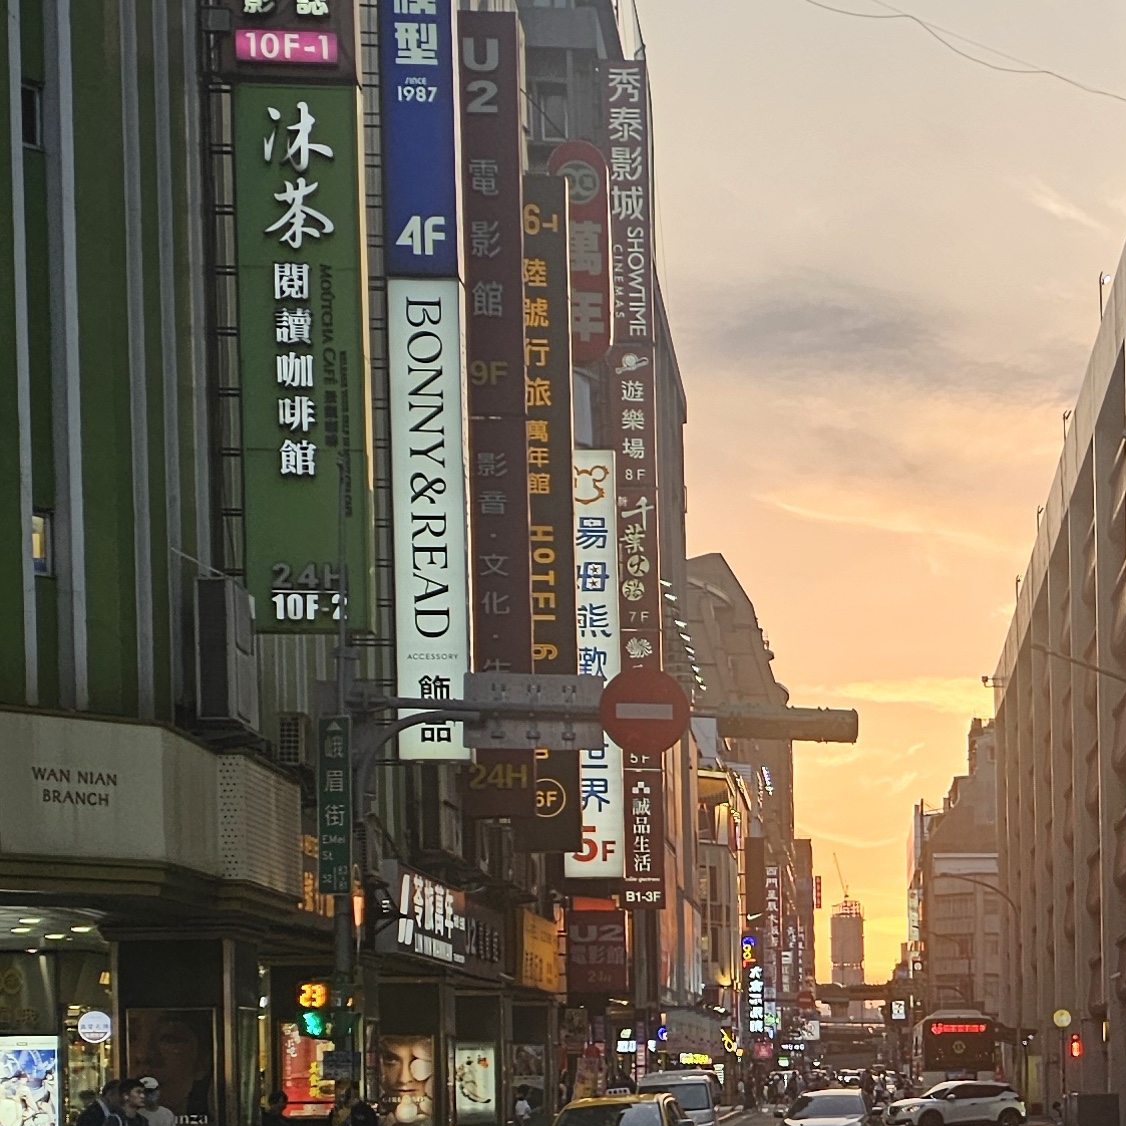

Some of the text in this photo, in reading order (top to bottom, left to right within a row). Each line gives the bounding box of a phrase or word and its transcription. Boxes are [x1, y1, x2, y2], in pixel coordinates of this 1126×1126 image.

[245, 32, 328, 59] 10F-1
[397, 86, 438, 102] 1987
[608, 67, 645, 221] 秀泰影城
[263, 101, 335, 249] 沐茶
[395, 215, 446, 256] 4F
[469, 158, 503, 318] 電影館
[612, 243, 625, 319] CINEMAS
[627, 226, 647, 337] SHOWTIME
[273, 262, 317, 476] 閱讀咖啡館
[470, 361, 508, 386] 9F
[621, 380, 646, 460] 遊樂場
[530, 525, 556, 621] HOTEL
[32, 766, 118, 787] WAN NIAN
[469, 763, 528, 789] 24H
[42, 788, 110, 807] BRANCH
[572, 825, 617, 862] 5F
[631, 797, 652, 872] 誠品生活
[625, 890, 662, 902] B1-3F
[568, 924, 624, 942] U2
